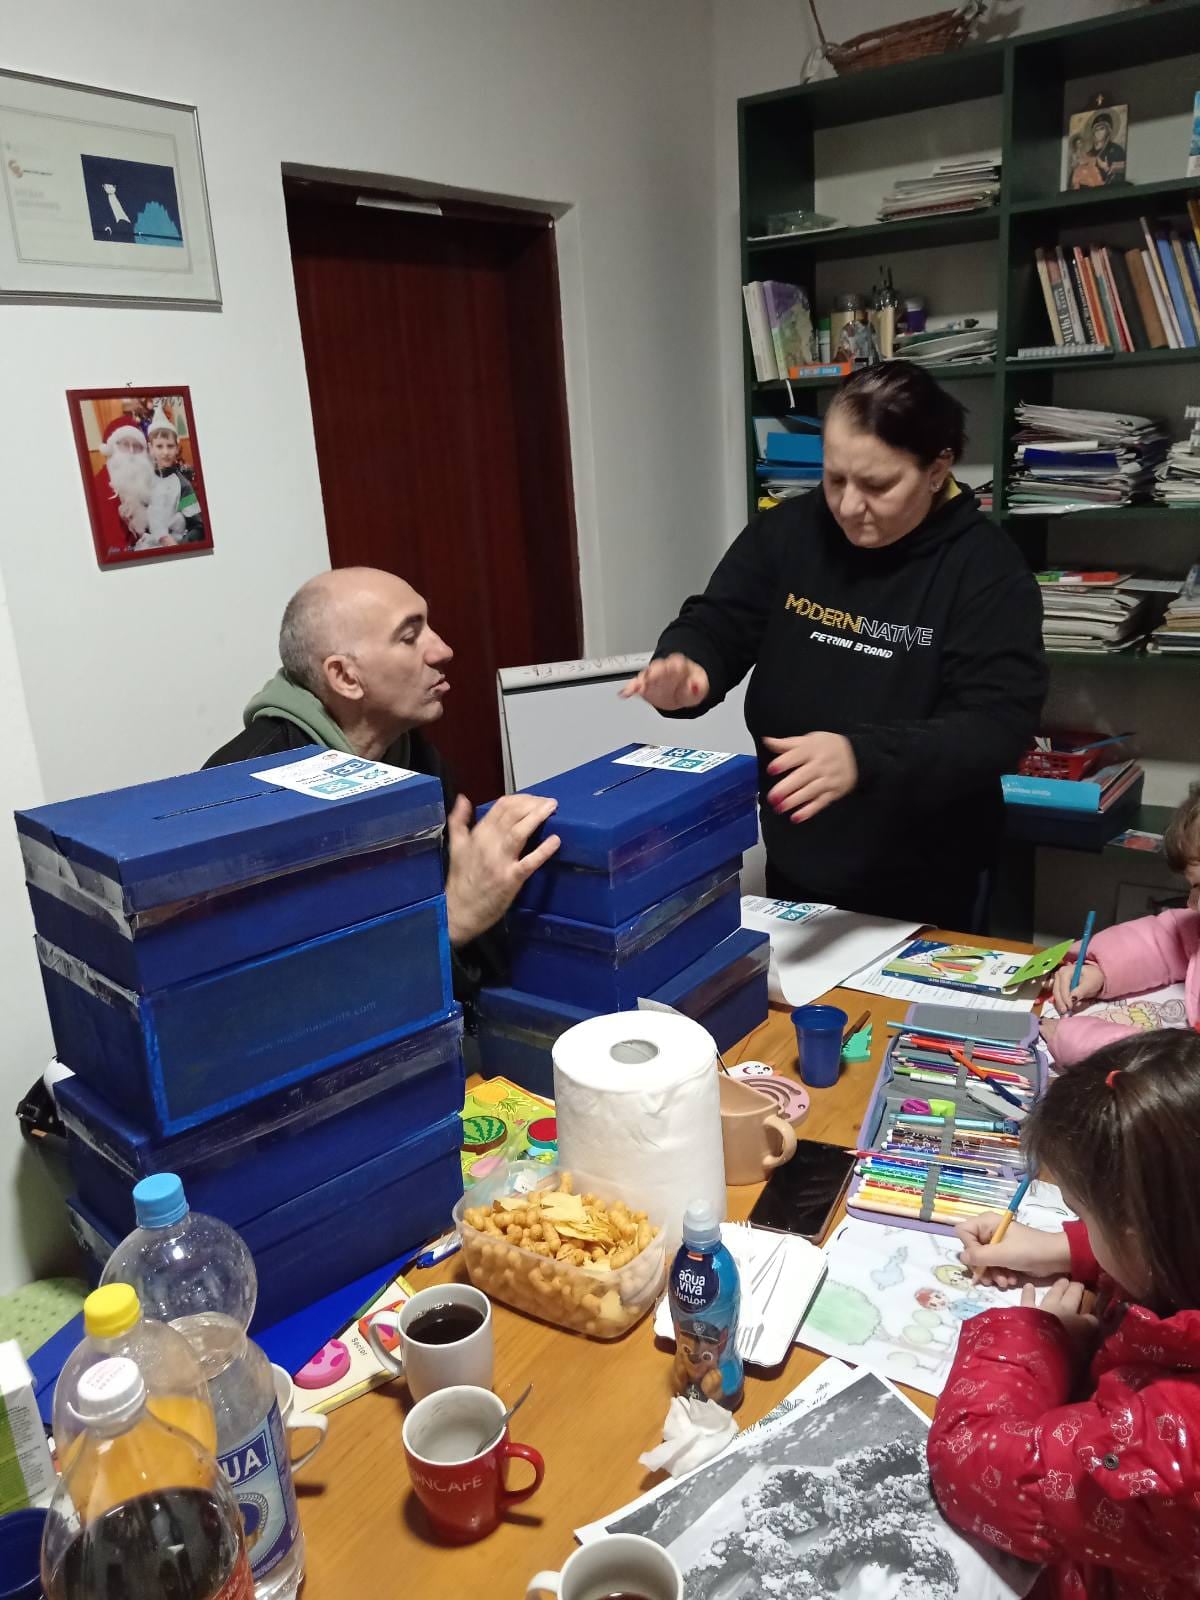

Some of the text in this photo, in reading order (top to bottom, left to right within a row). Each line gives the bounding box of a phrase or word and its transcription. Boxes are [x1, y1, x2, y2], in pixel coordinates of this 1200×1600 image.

[785, 592, 861, 634] MODERN
[809, 631, 893, 659] FERRINI BRAND
[679, 1279, 703, 1296] viva
[221, 1448, 263, 1483] UA
[415, 1471, 484, 1493] NCAFE
